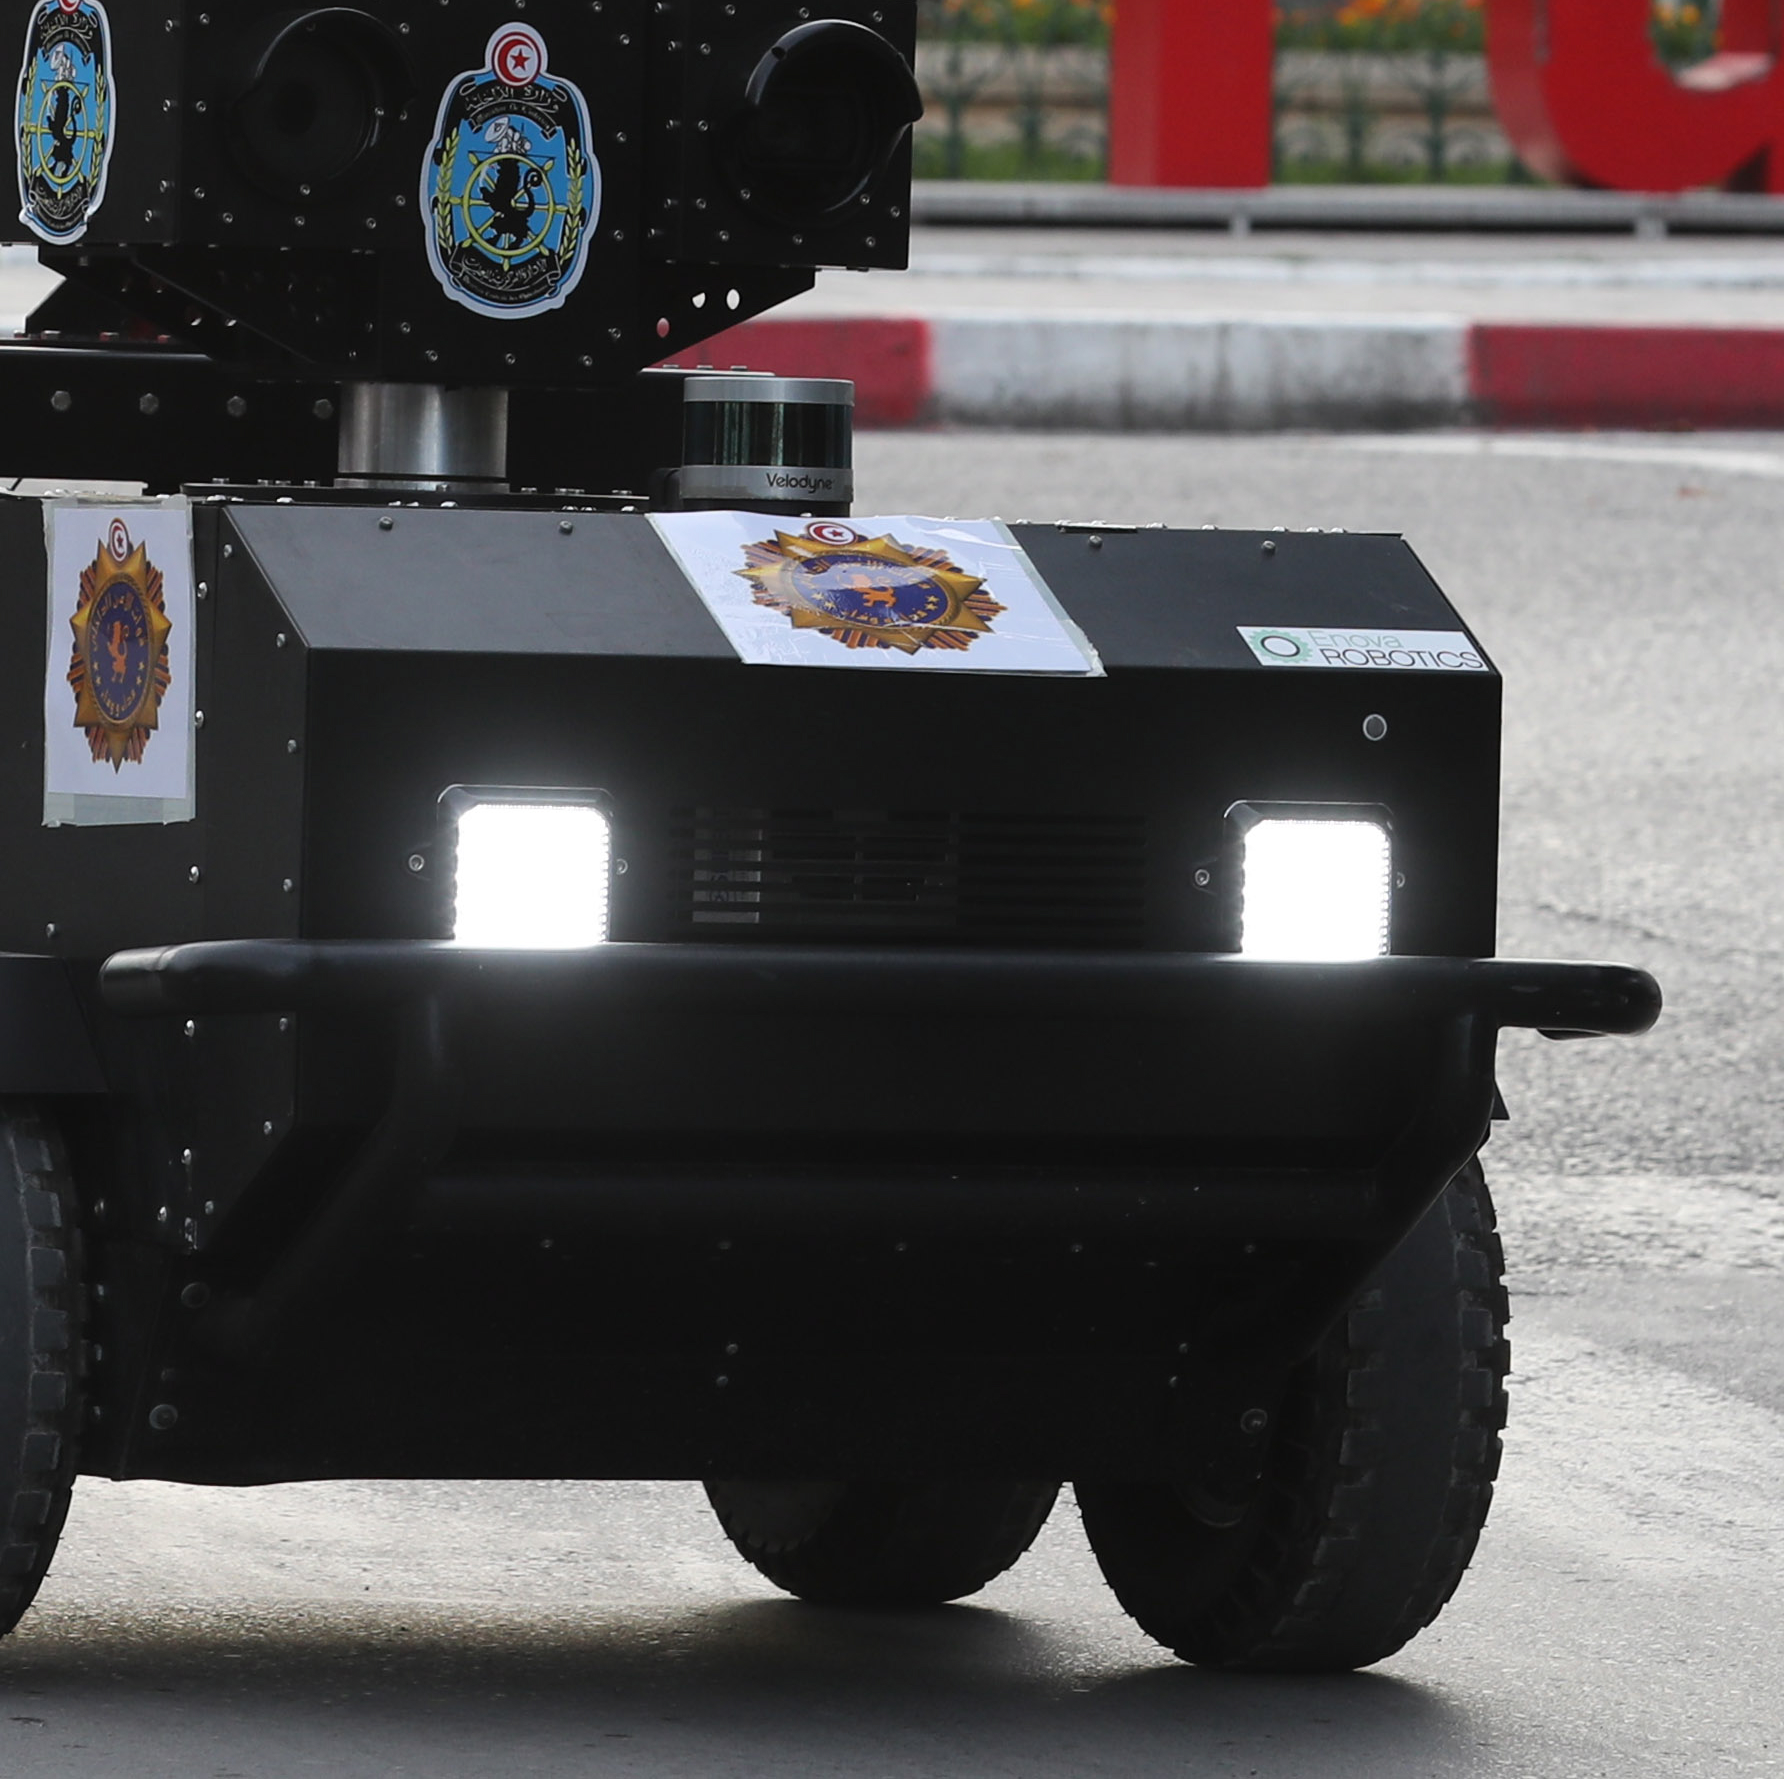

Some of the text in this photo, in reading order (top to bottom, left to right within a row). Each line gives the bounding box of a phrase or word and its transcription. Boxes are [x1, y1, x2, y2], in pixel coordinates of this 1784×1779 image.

[766, 473, 833, 494] Velodyne
[1308, 630, 1404, 648] Enova
[1319, 648, 1484, 669] ROBOTICS
